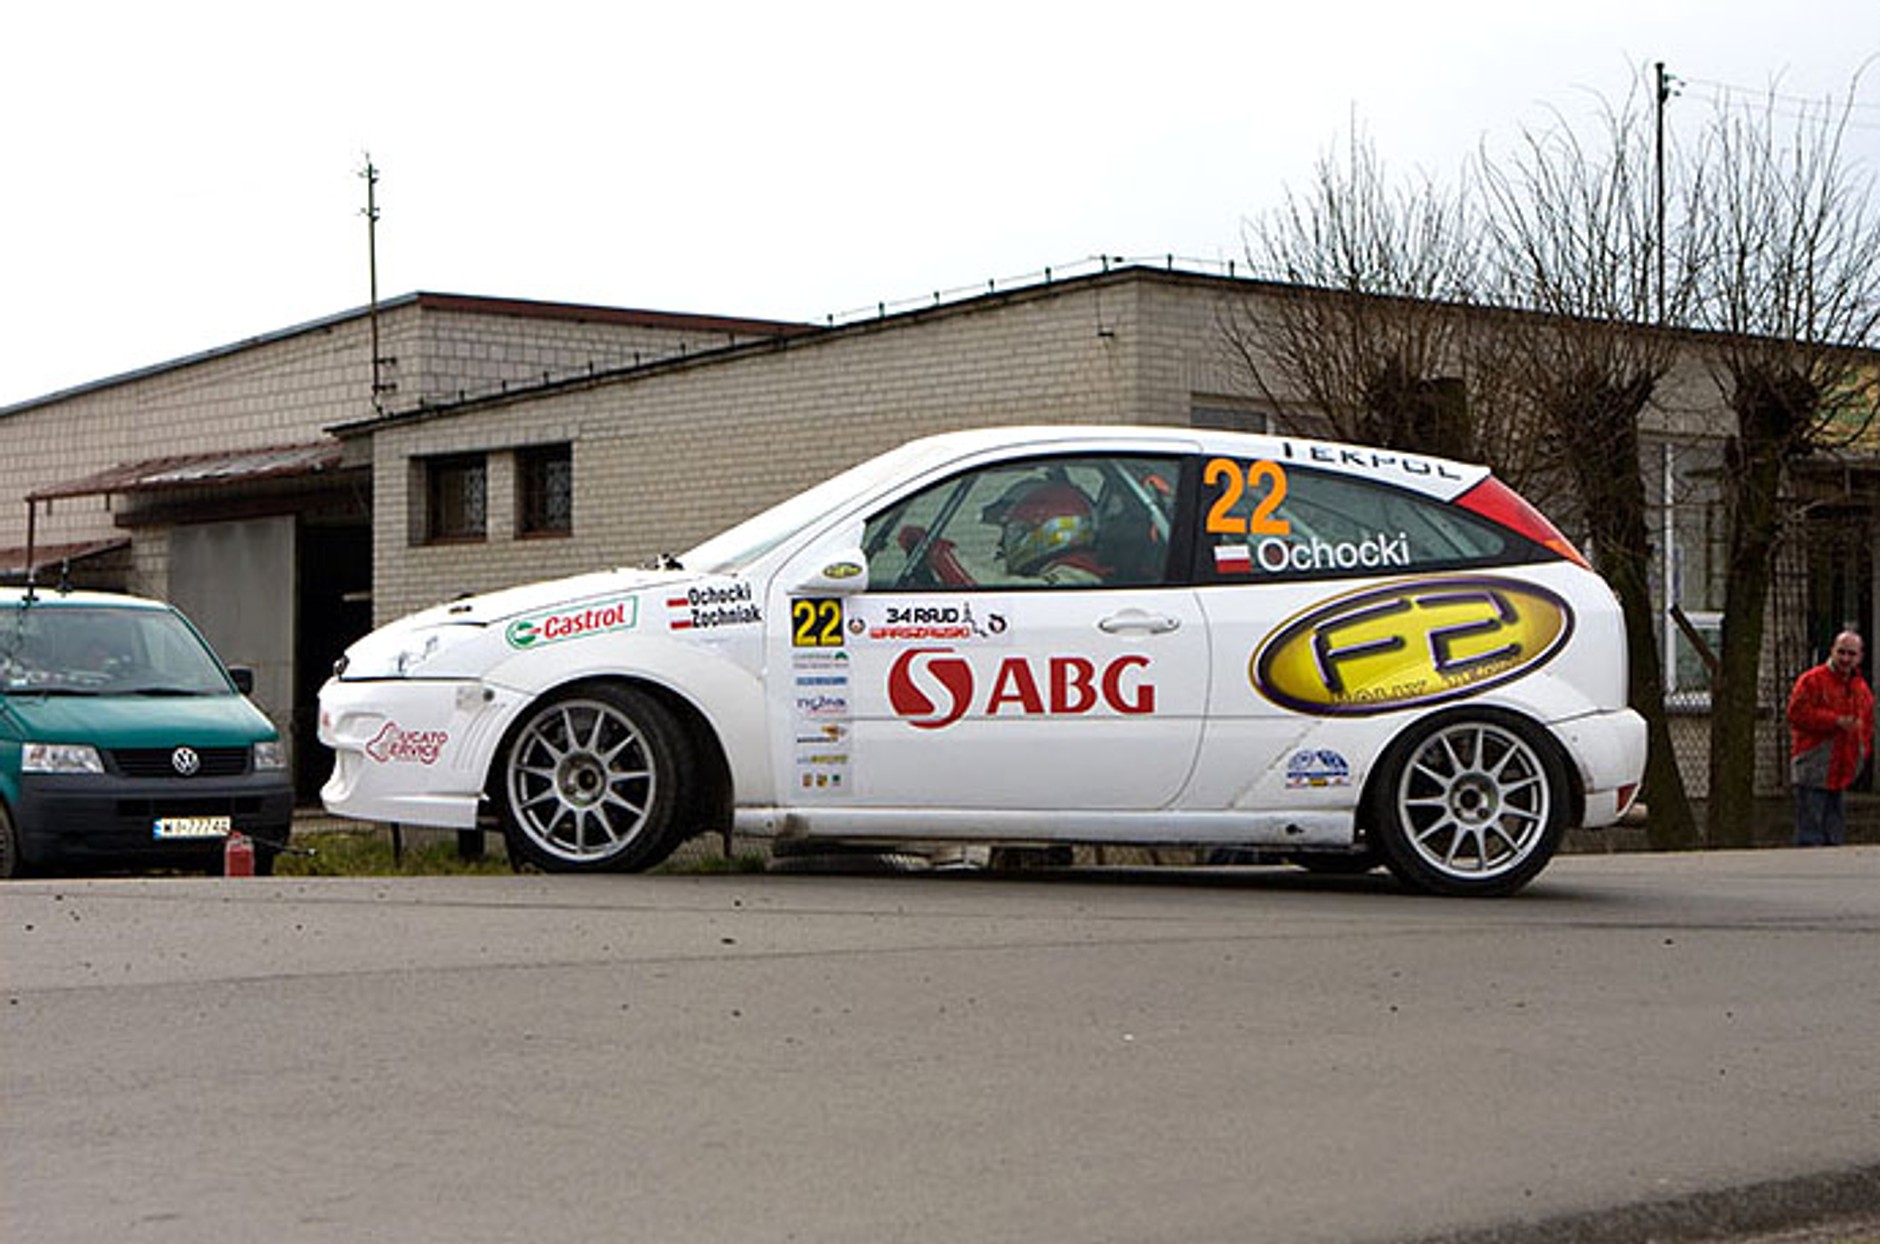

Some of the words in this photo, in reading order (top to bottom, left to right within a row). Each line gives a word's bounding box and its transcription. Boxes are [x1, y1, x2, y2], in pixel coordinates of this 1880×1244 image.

[1203, 457, 1292, 535] 22
[1257, 532, 1411, 572] Ochocki
[687, 582, 752, 607] Ochocki
[543, 602, 626, 640] Castrol
[793, 600, 843, 646] 22
[886, 607, 911, 624] 34
[914, 607, 960, 624] RAJD
[985, 655, 1155, 715] ABG
